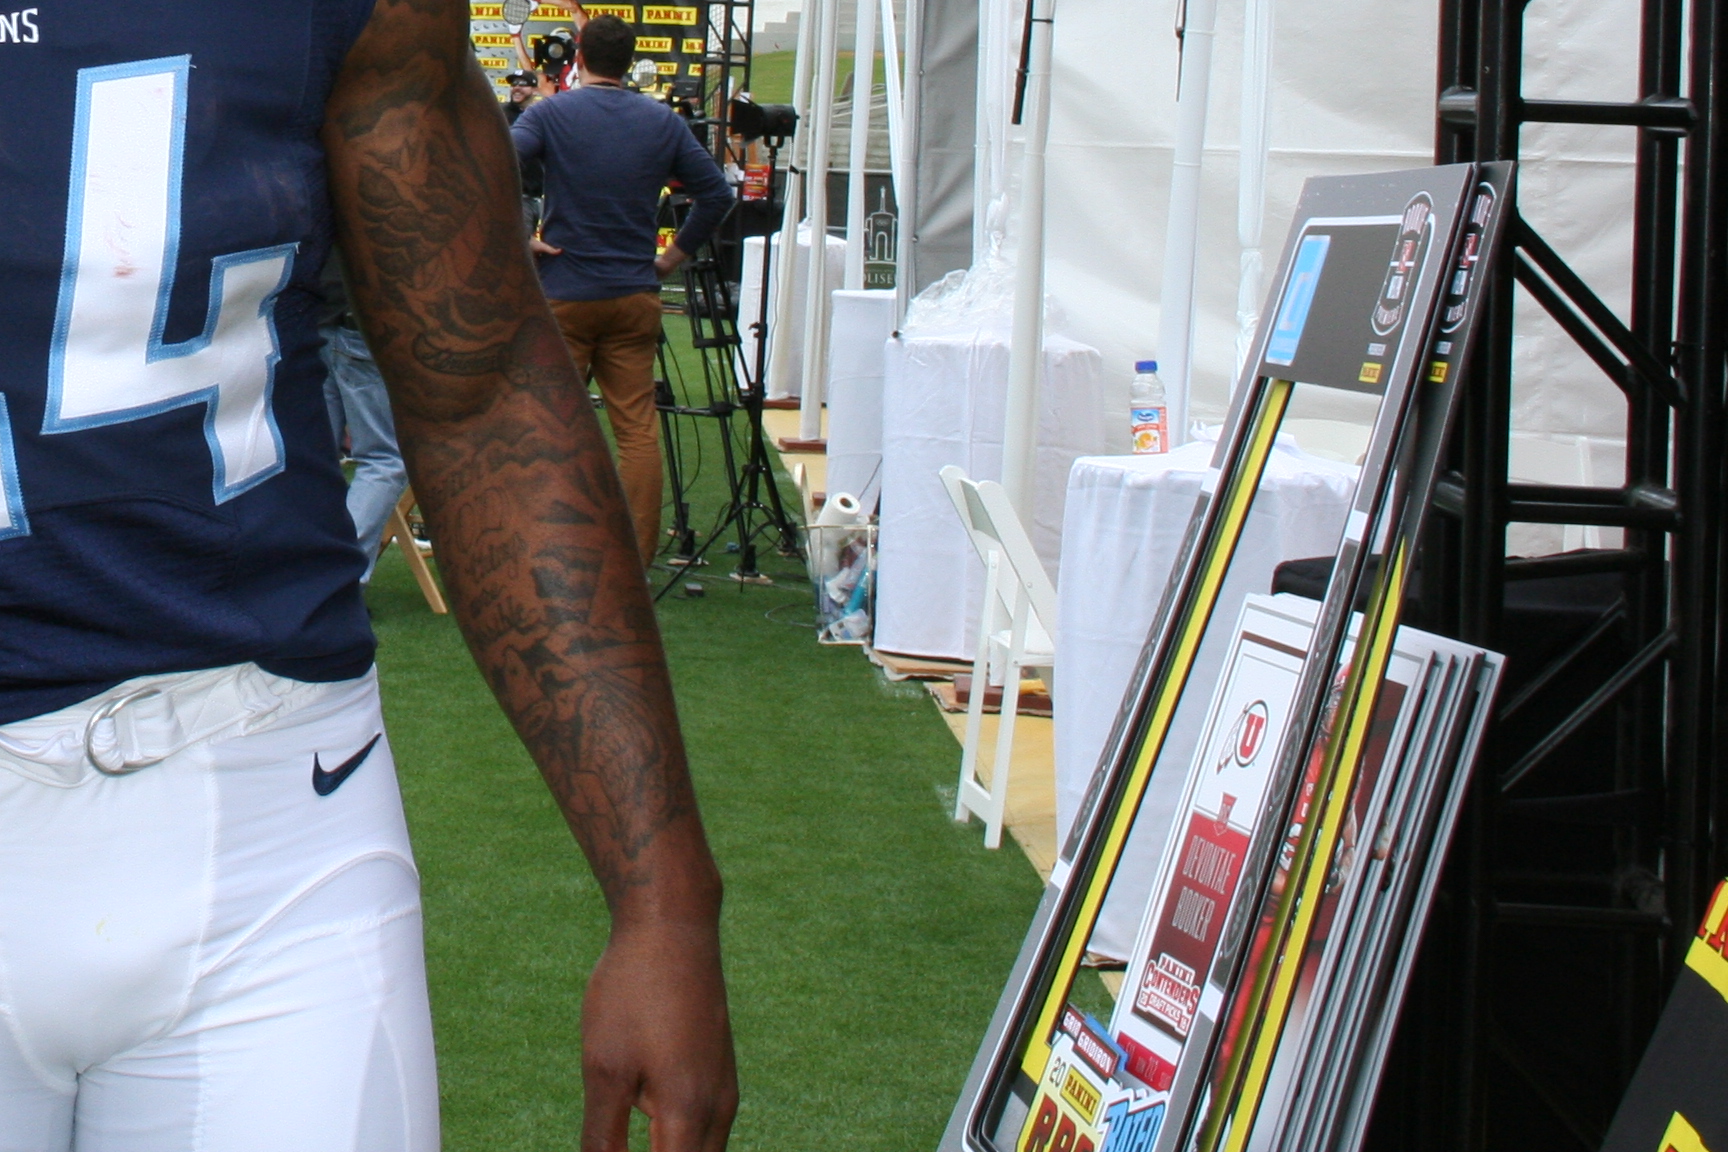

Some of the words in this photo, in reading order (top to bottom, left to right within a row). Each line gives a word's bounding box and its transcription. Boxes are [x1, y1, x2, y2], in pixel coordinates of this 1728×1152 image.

[1171, 885, 1216, 943] BOOKER
[1143, 963, 1200, 1016] CONTENDERS
[1159, 956, 1194, 984] PANINI
[1064, 1070, 1097, 1115] PANINI
